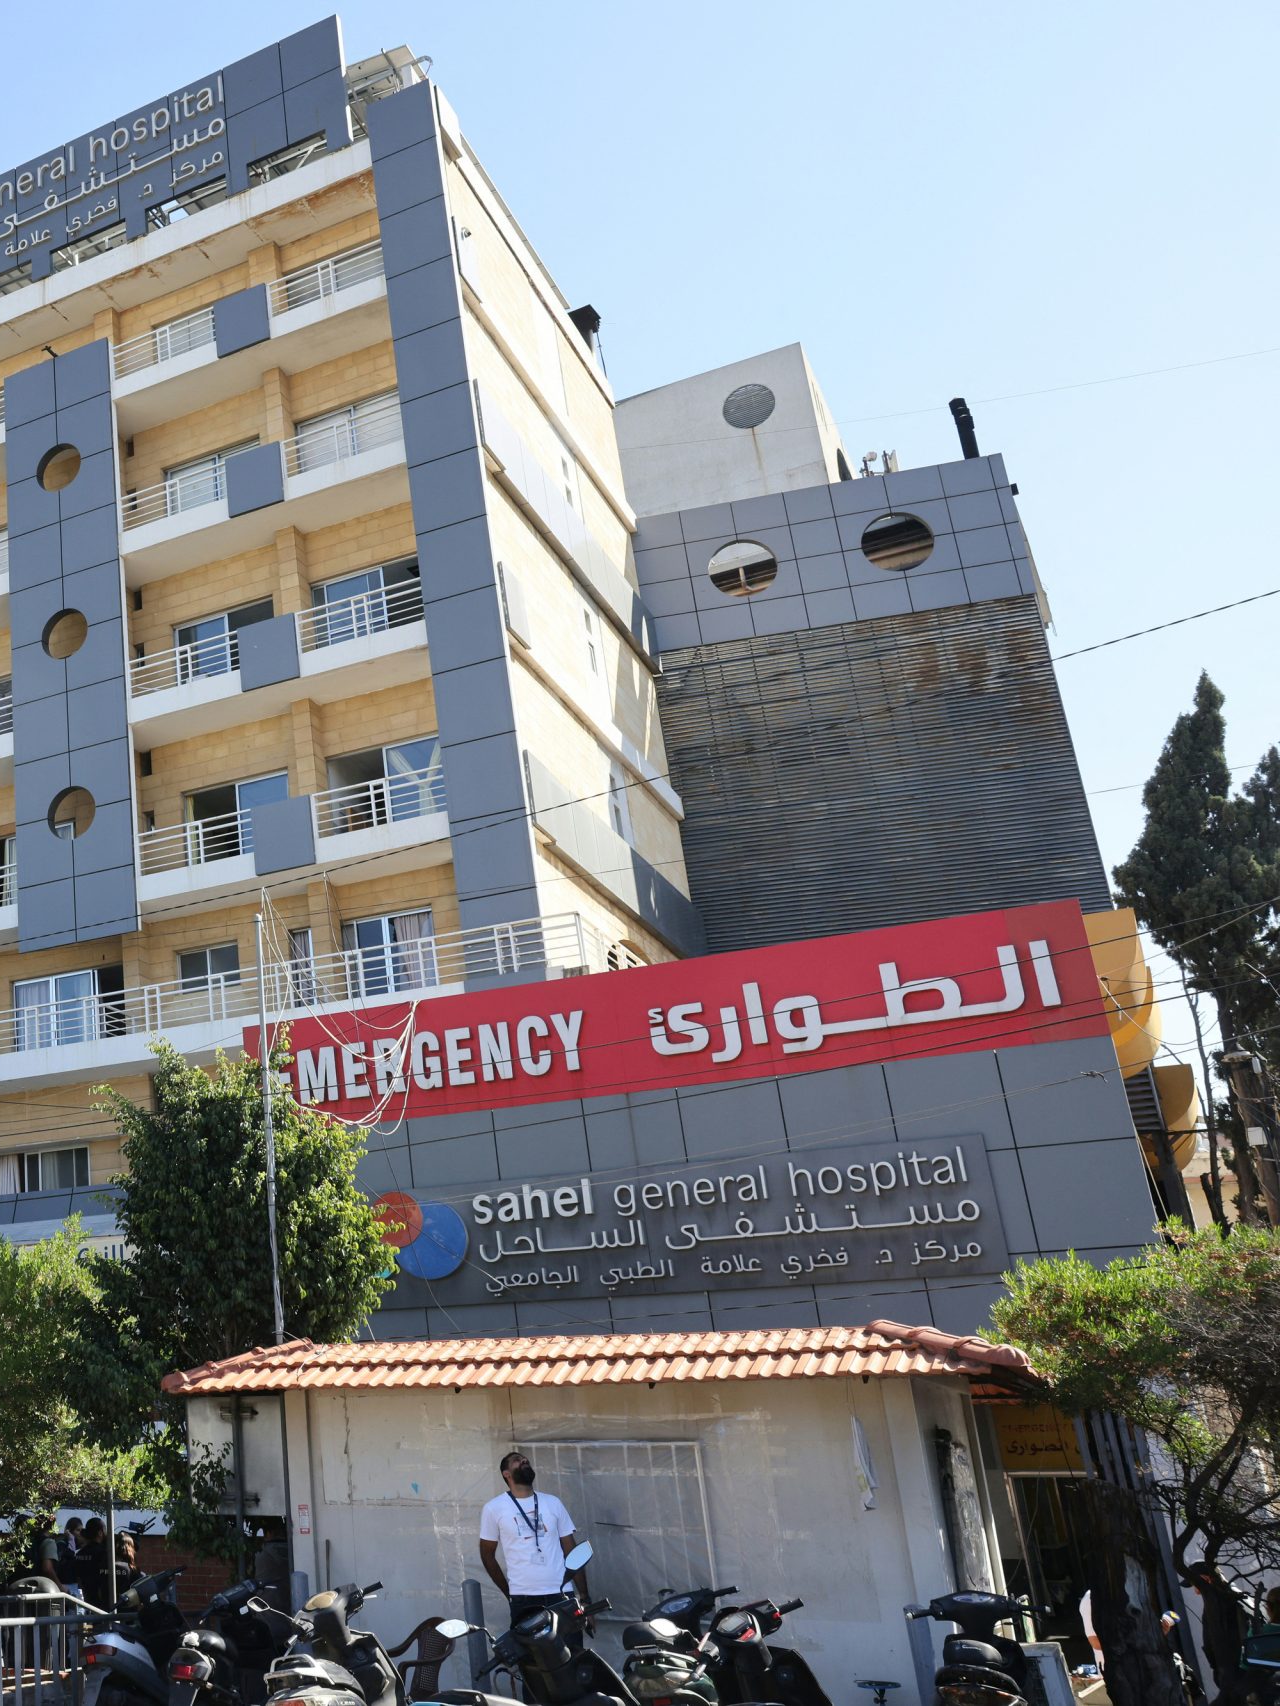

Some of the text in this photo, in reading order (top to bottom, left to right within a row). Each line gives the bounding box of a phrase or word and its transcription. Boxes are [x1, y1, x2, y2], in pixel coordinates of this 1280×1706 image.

[89, 75, 225, 164] hospital
[648, 939, 1062, 1064] الطوارئ
[472, 1145, 969, 1225] sahel general hospital
[479, 1198, 981, 1264] مستشفى الساحل
[911, 1239, 983, 1266] مركز
[485, 1265, 581, 1298] الجامعي
[599, 1258, 676, 1292] الطبي
[779, 1246, 850, 1281] فخري
